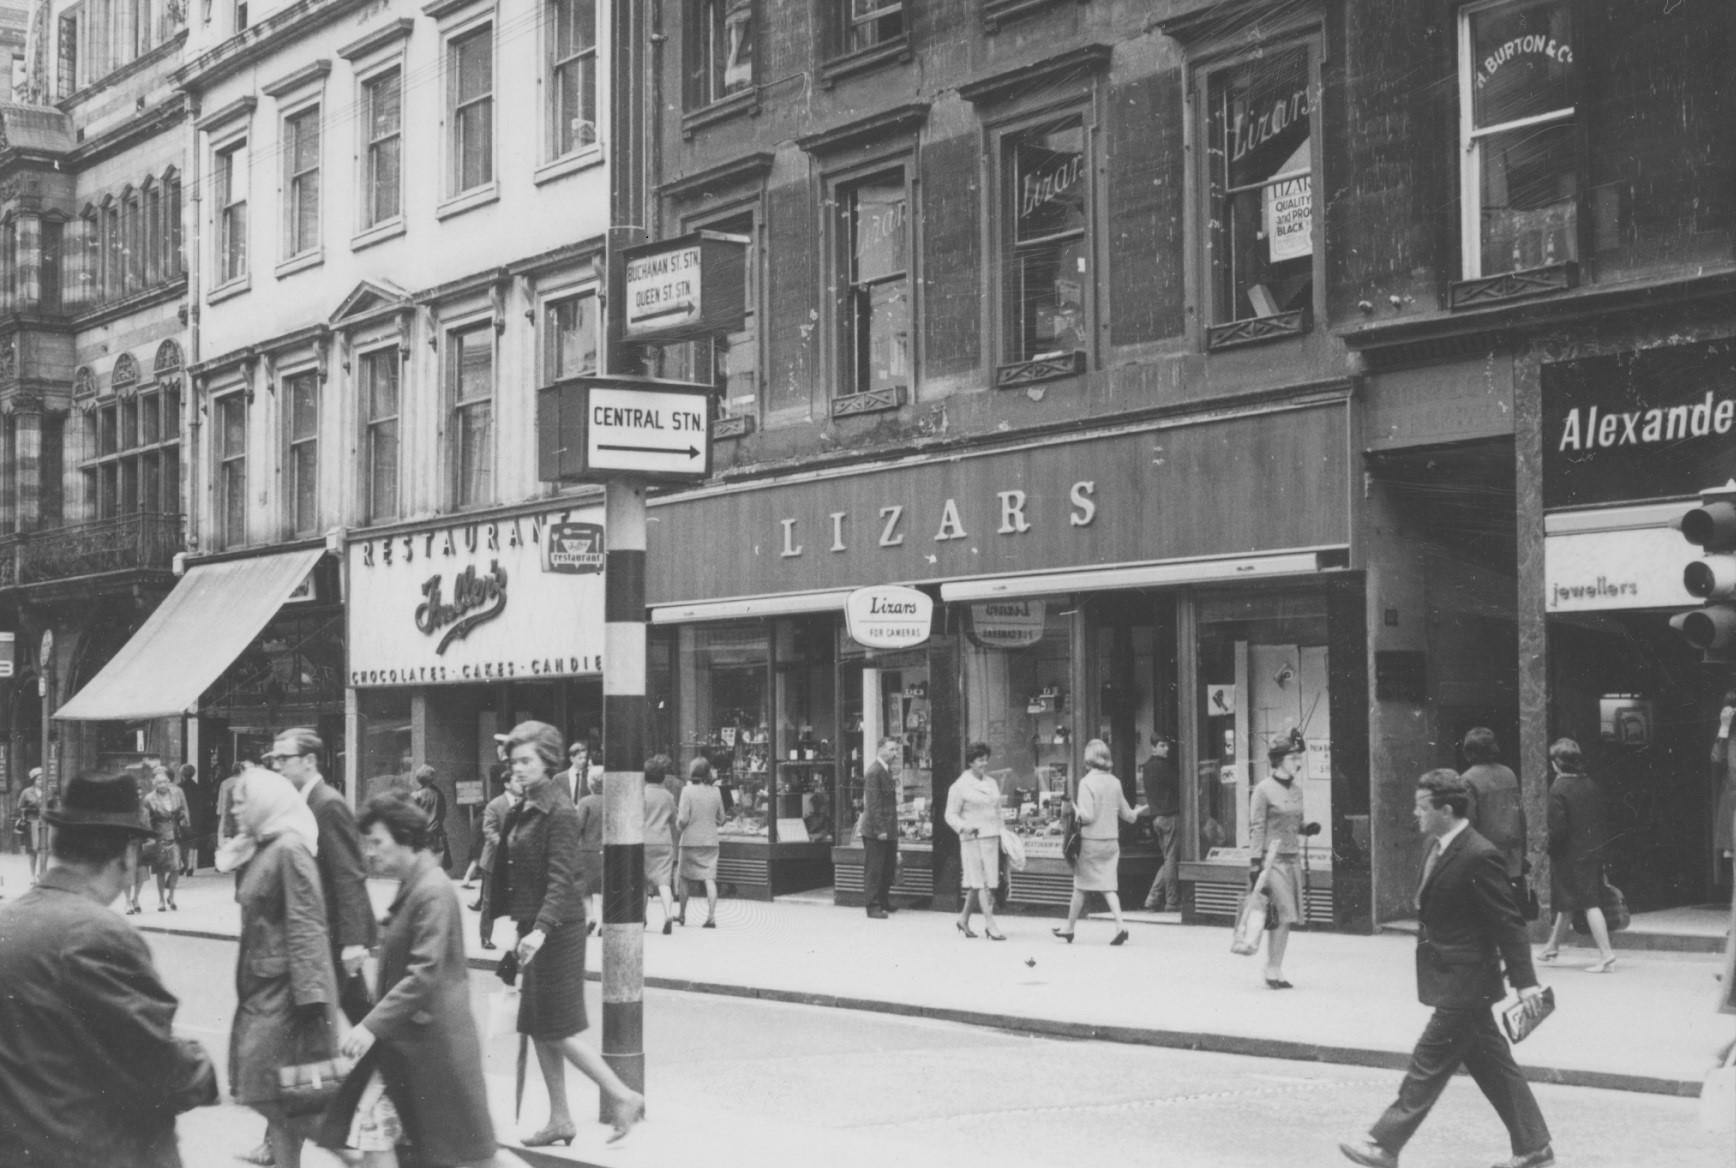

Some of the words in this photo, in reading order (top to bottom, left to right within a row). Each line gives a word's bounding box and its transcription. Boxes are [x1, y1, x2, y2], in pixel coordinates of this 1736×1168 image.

[1484, 34, 1546, 75] BURTON
[1275, 196, 1311, 212] QUALITY
[1276, 222, 1304, 237] BLACK
[627, 256, 668, 283] BUCHANAN
[636, 288, 660, 308] QUEEN
[594, 406, 664, 429] CENTRAL
[672, 412, 705, 432] STN.
[1558, 390, 1735, 451] Alexande
[780, 480, 1097, 558] LIZARS
[553, 553, 600, 562] restaurant
[1551, 576, 1638, 608] jewellers
[869, 596, 917, 614] Lizars
[869, 628, 884, 638] FOR
[886, 628, 921, 638] CAMERAS
[352, 666, 446, 685] CHOCOLATES
[462, 661, 514, 679] CAKES
